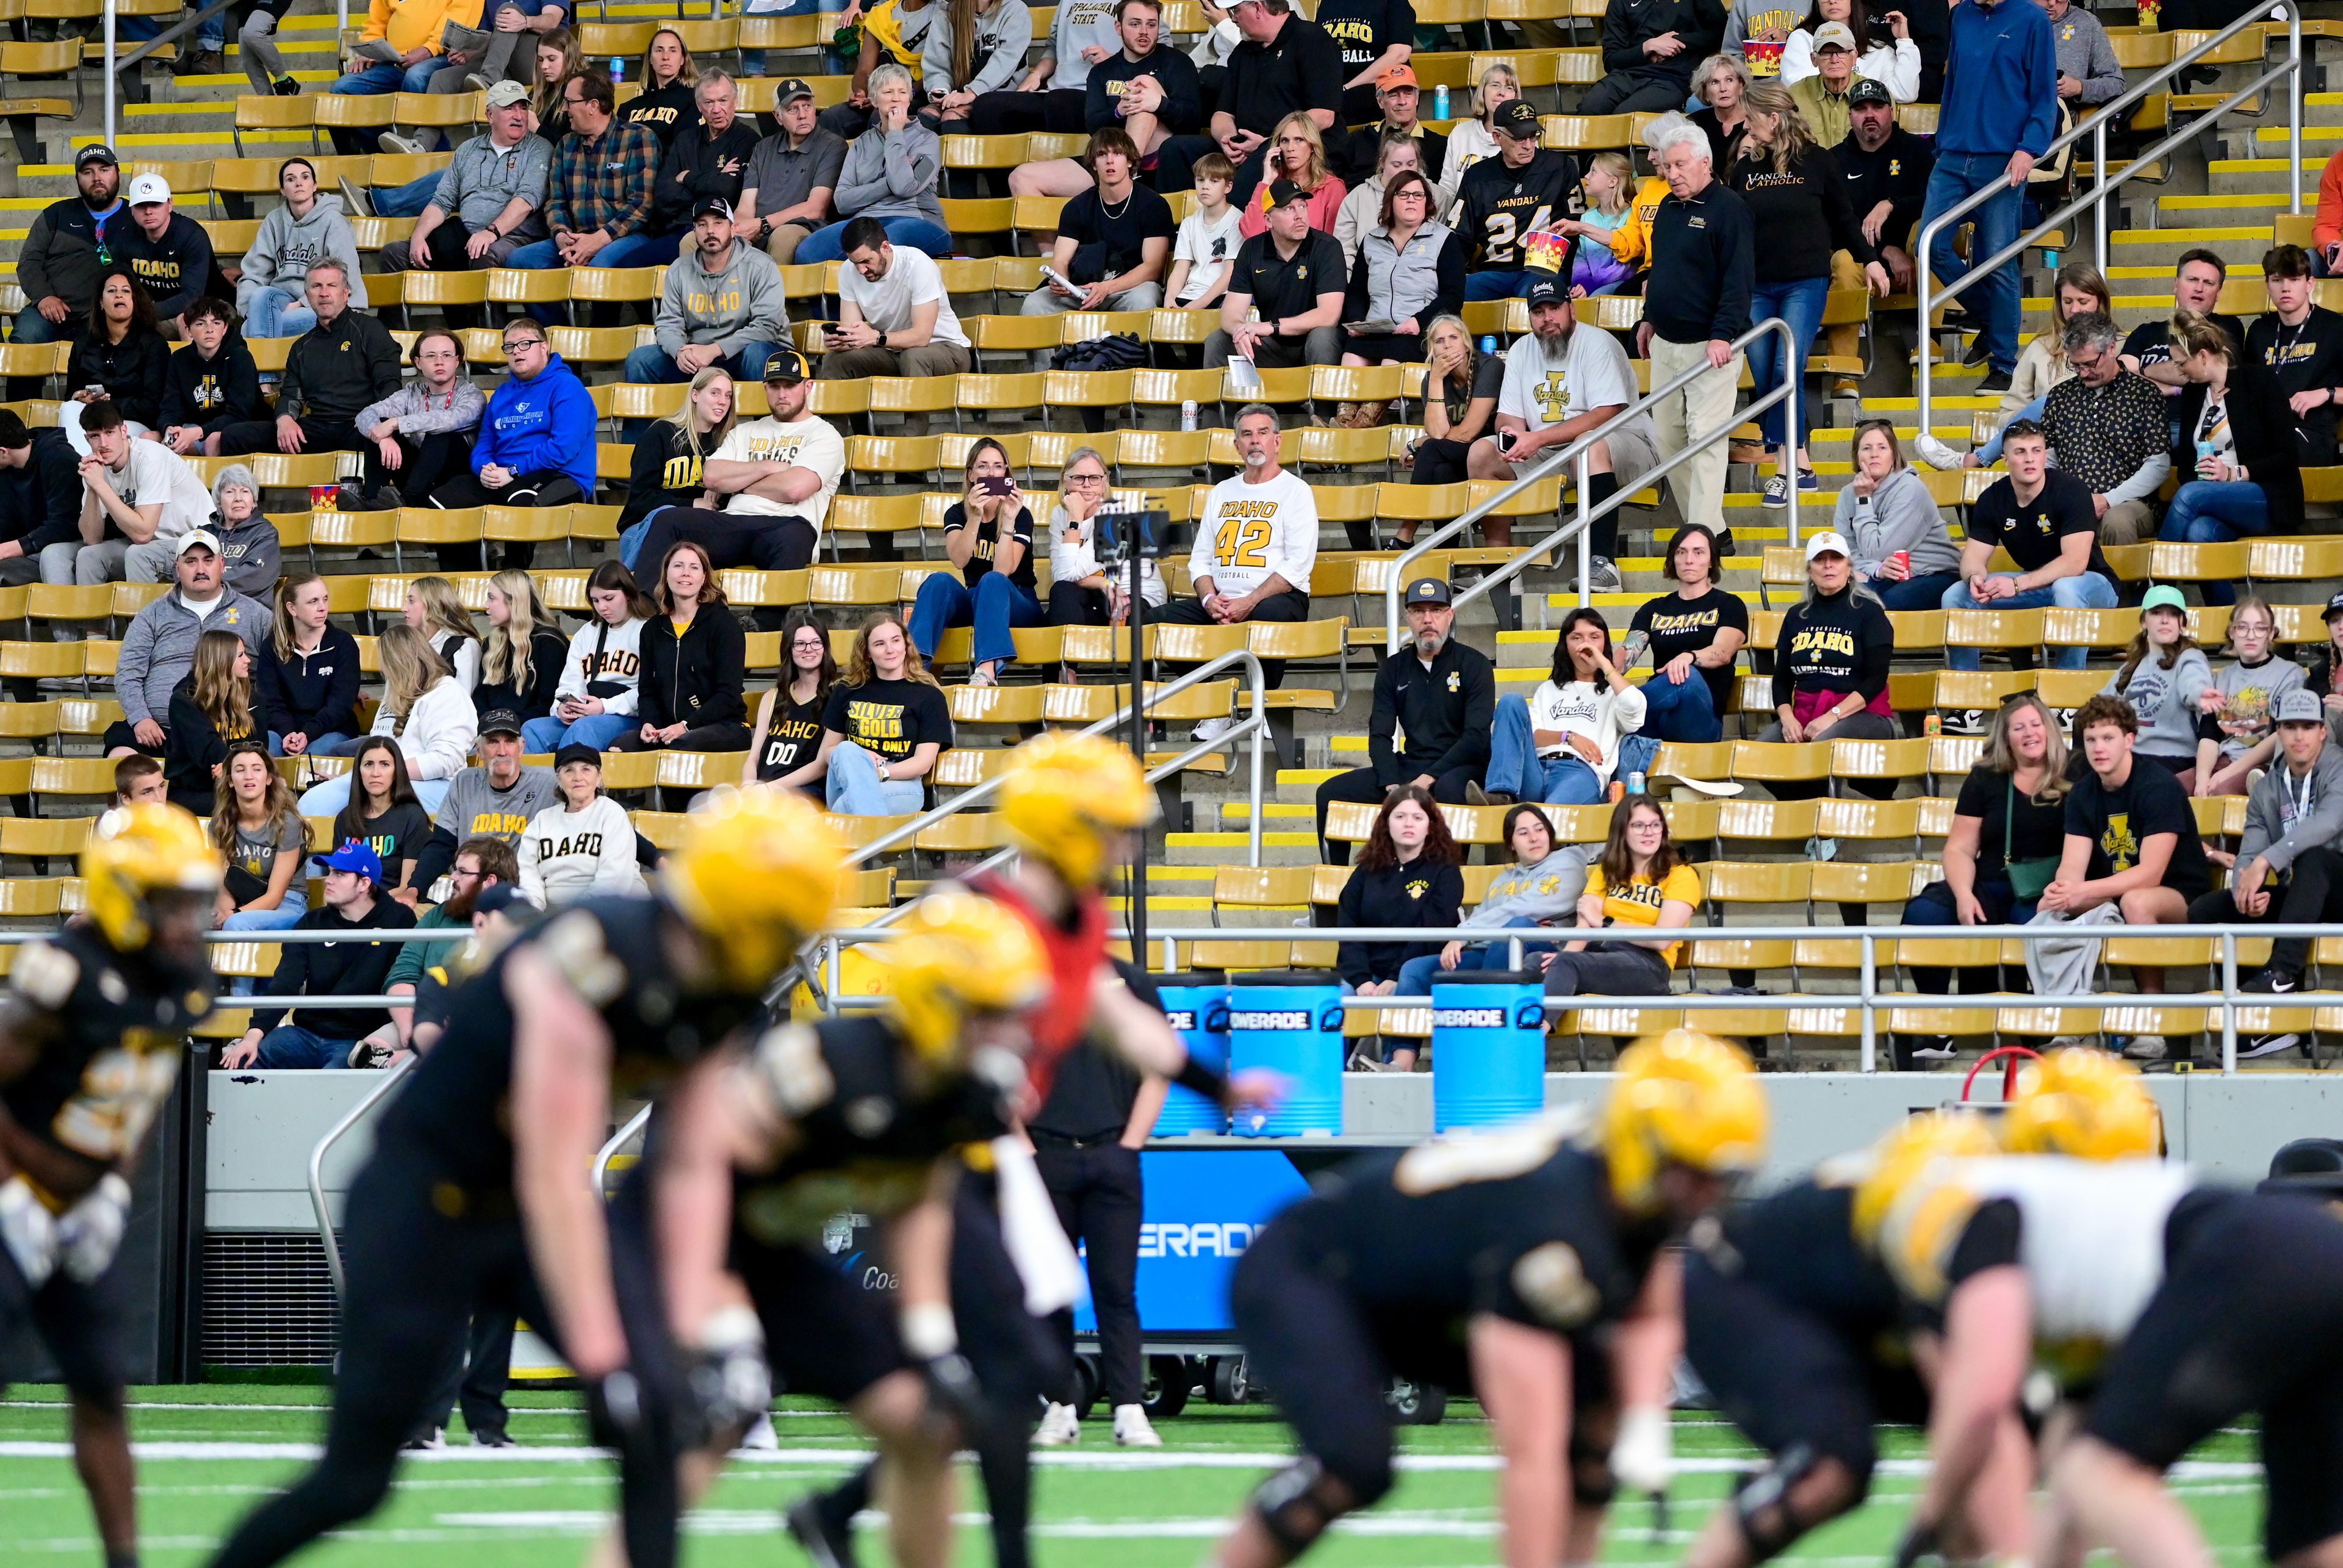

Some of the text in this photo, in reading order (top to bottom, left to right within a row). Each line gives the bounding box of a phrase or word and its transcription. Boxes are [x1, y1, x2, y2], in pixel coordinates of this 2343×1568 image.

[1072, 13, 1096, 24] STATE
[1323, 22, 1372, 42] DAHO
[1342, 51, 1375, 63] BALL
[1862, 83, 1872, 95] P
[629, 106, 678, 125] IDAHO
[81, 147, 107, 161] IDAHO
[1746, 176, 1804, 190] CATHOLIC
[1497, 195, 1539, 208] VANDALS
[1485, 205, 1552, 262] 24
[277, 243, 318, 269] Vndal
[132, 258, 179, 279] IDAHO
[1533, 282, 1554, 293] Vandals
[2279, 342, 2317, 359] IAHO
[663, 455, 707, 489] IDA
[1217, 501, 1278, 518] IDAHO
[1214, 520, 1272, 567] 42
[1650, 608, 1719, 631] IDAHO
[1661, 626, 1699, 636] FOOTBALL
[1791, 631, 1854, 656] IDAHO
[582, 651, 639, 680] DAHO
[689, 694, 702, 711] IDA
[849, 700, 904, 719] SILVER
[1550, 698, 1597, 723] Vandals
[769, 720, 820, 739] DAHO
[859, 719, 901, 737] GOLD
[766, 742, 797, 765] 00
[882, 739, 911, 753] ONLY
[471, 813, 528, 833] IDAHO
[236, 844, 272, 858] AHO
[539, 832, 602, 861] DAHO
[2102, 829, 2139, 856] Vanls
[1608, 884, 1663, 908] DAHO
[1229, 1012, 1307, 1030] OWERADE
[1433, 1009, 1502, 1027] WERADE
[1138, 1223, 1250, 1257] ERAD
[863, 1265, 899, 1290] Coa
